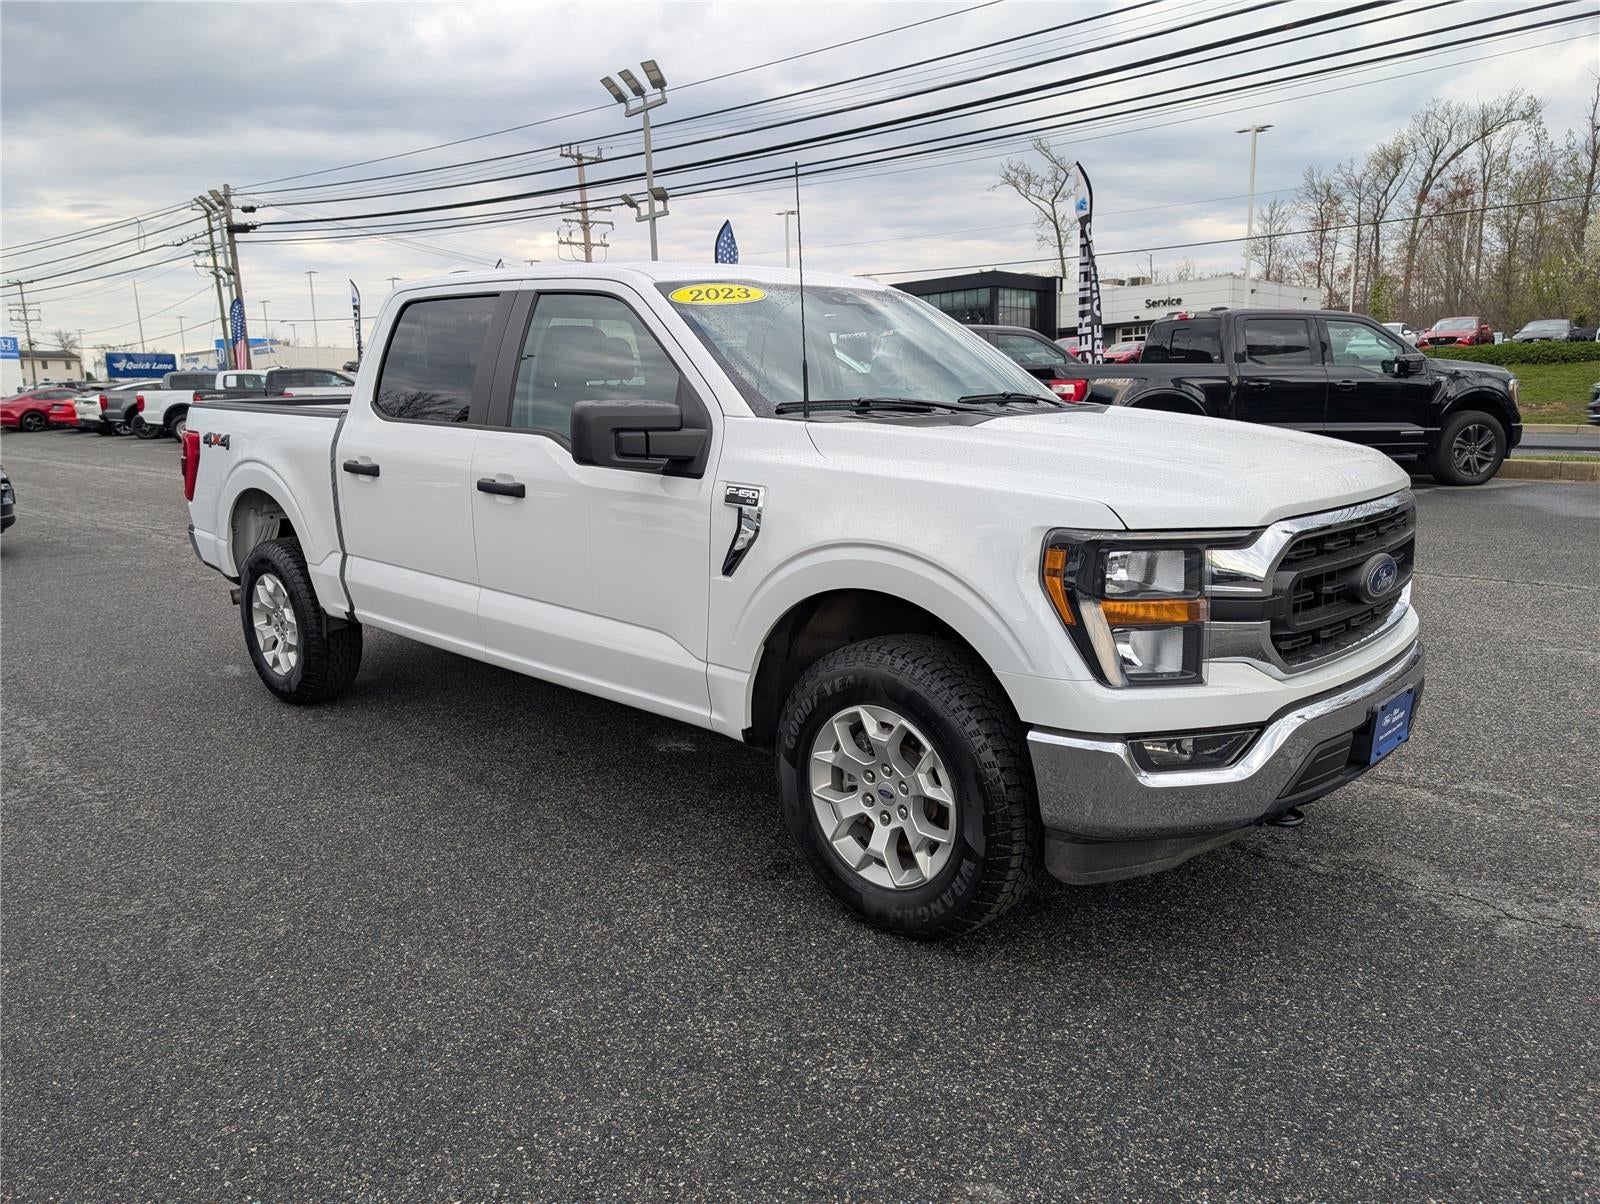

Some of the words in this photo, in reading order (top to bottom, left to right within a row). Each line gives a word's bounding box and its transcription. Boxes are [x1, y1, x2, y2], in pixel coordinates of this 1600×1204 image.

[689, 287, 751, 302] 2023
[1145, 296, 1182, 309] Service
[126, 361, 151, 370] Quick
[151, 362, 174, 370] Lane
[726, 487, 759, 499] F-150
[785, 674, 864, 750] GOODYEA
[884, 857, 977, 922] WRANGLE
